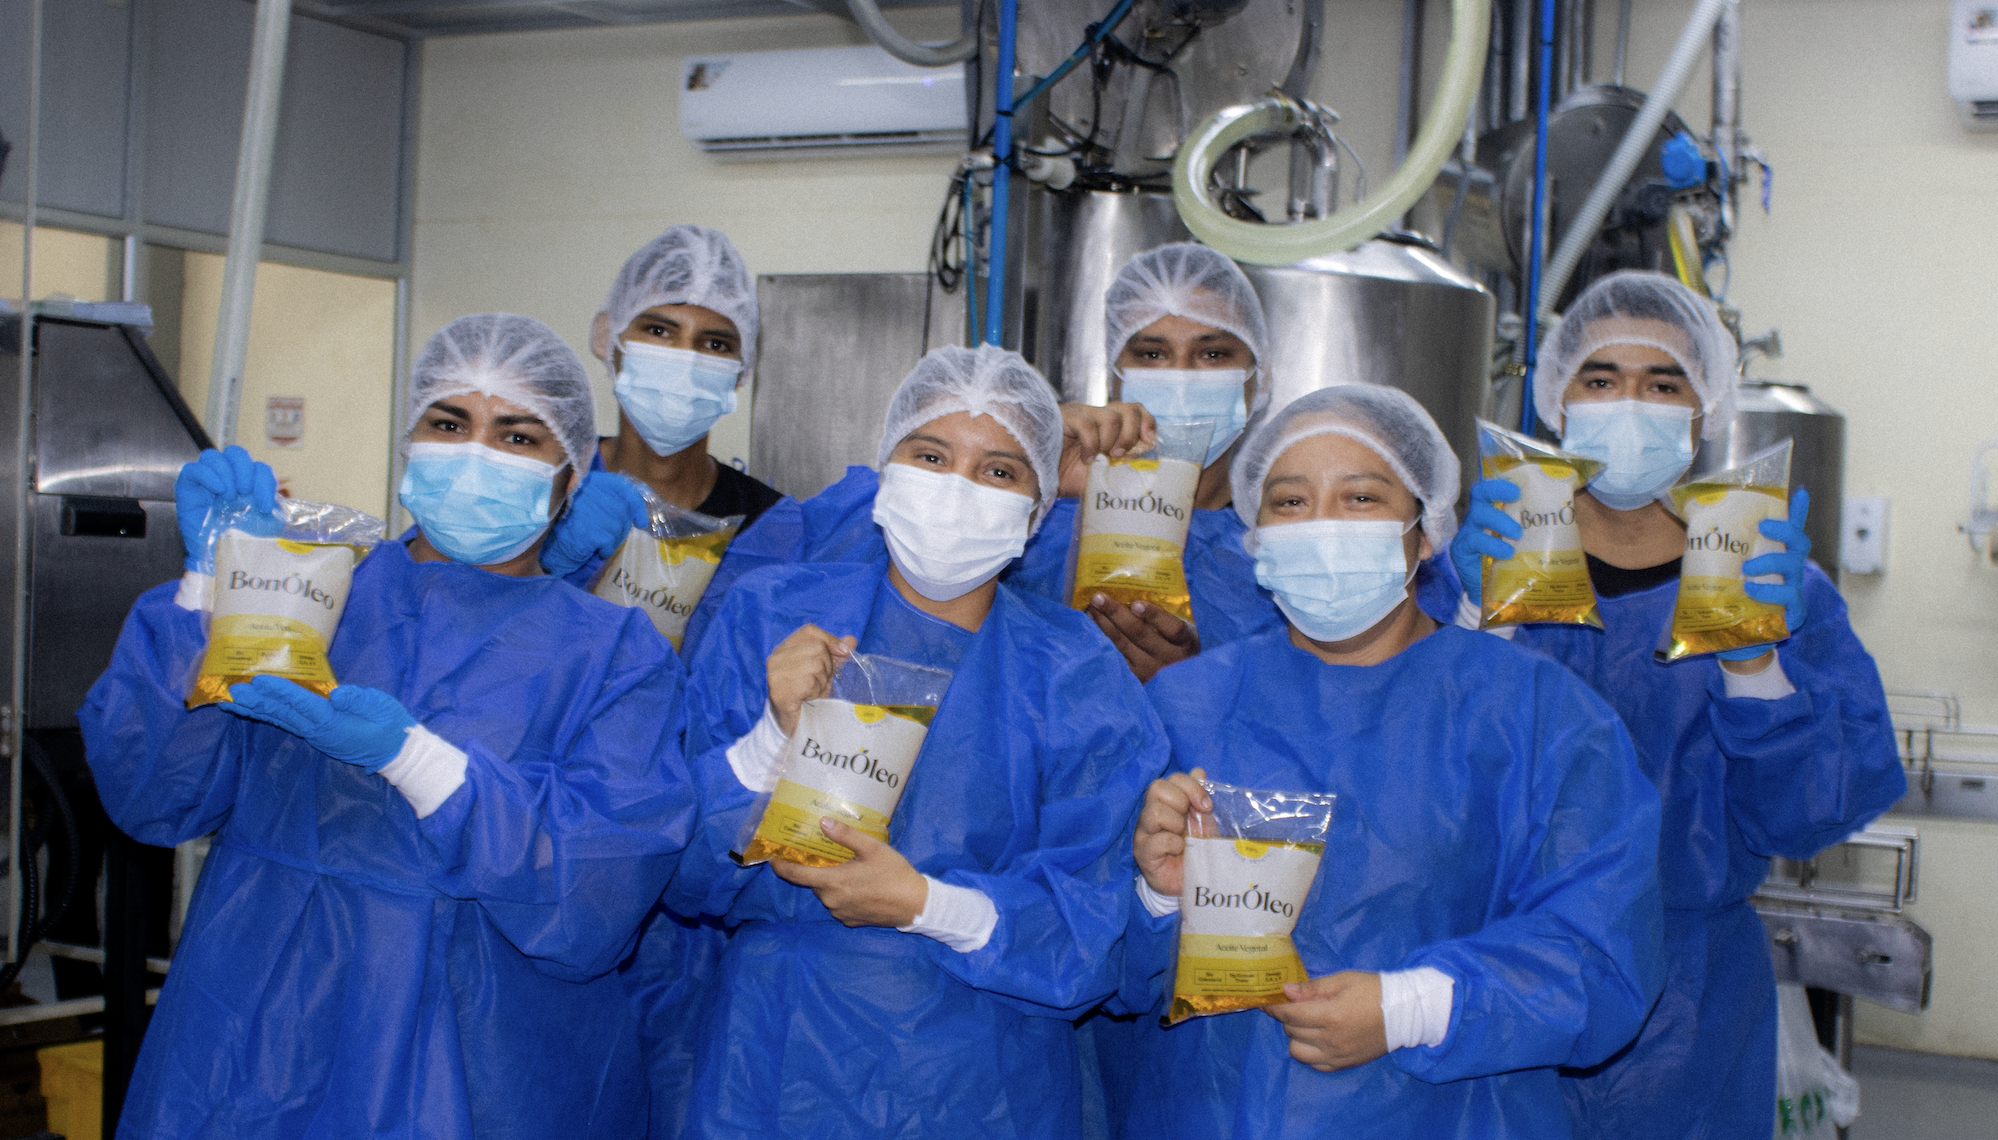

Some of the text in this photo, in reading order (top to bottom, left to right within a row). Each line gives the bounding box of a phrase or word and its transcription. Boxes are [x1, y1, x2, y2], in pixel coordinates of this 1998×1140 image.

[1095, 490, 1185, 521] BonÓleo
[1520, 501, 1576, 530] BonÓ
[1687, 526, 1749, 555] nÓleo
[230, 570, 335, 610] BonÓleo
[612, 568, 692, 617] BonÓleo
[801, 738, 899, 789] BonÓleo
[1194, 883, 1294, 918] BonÓleo
[1217, 944, 1268, 954] Aceite Vegetal
